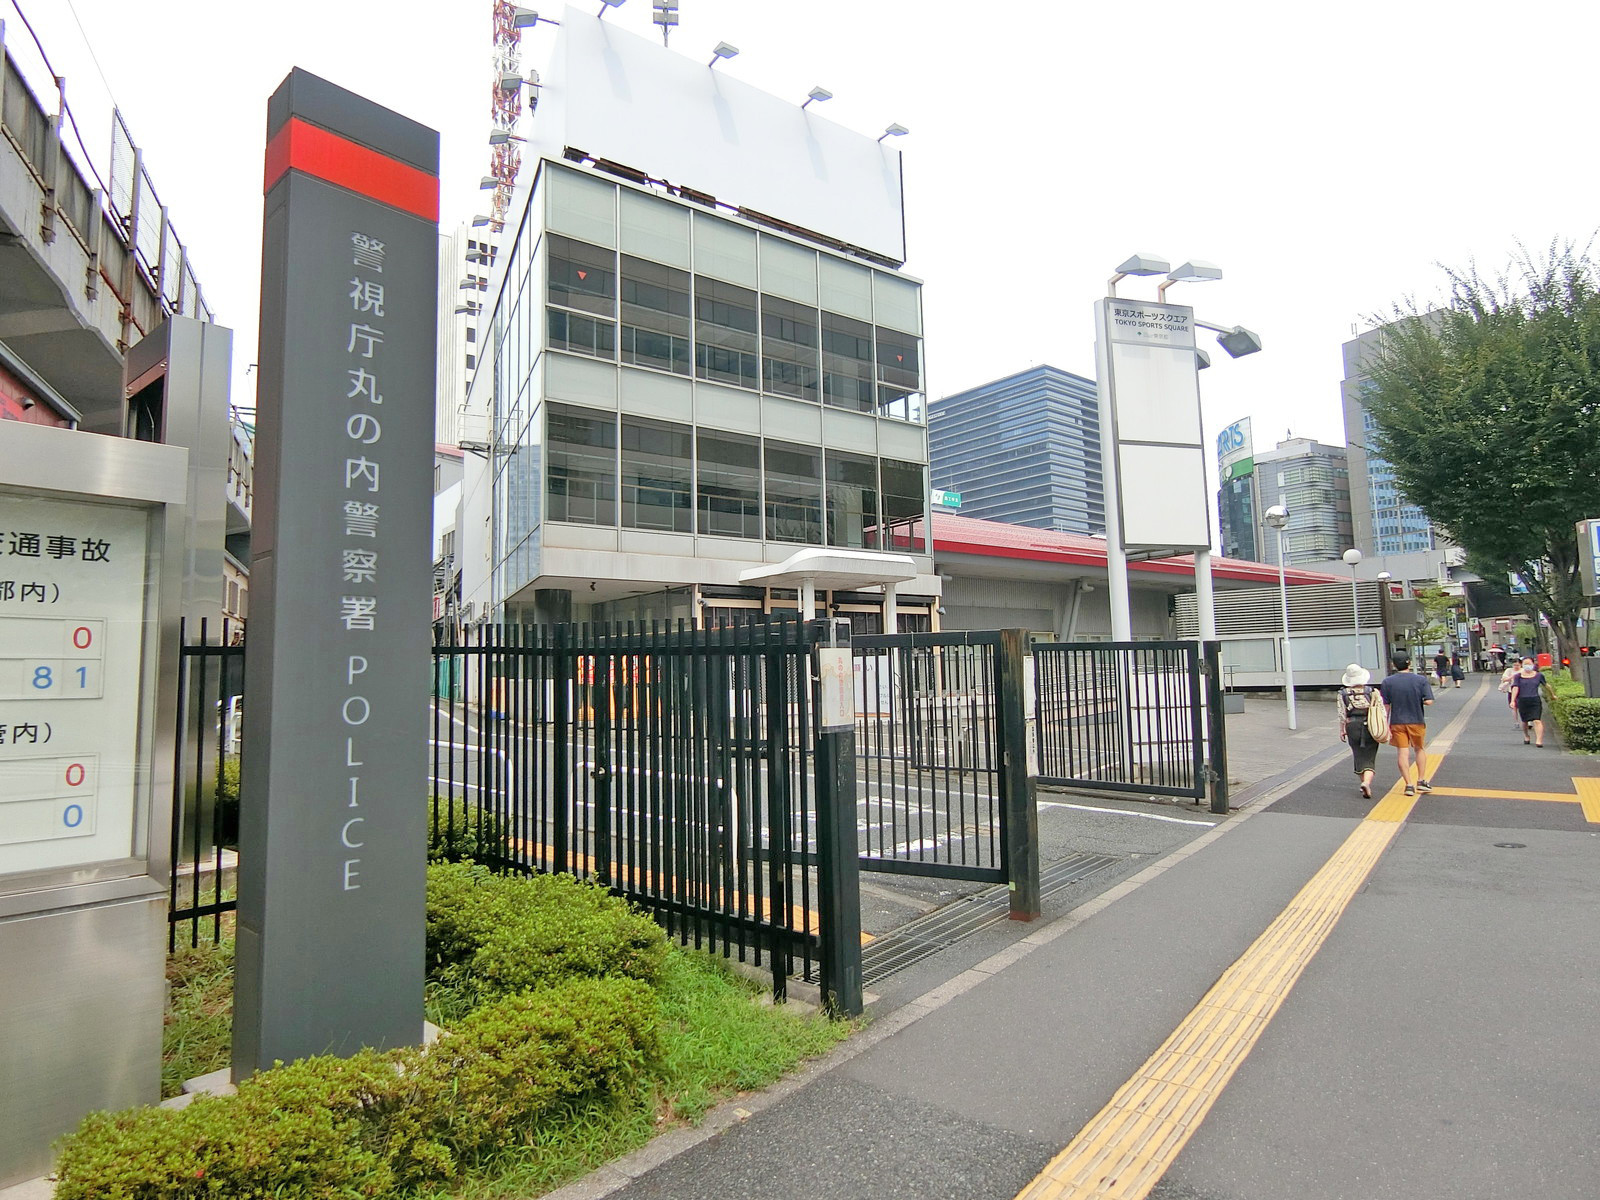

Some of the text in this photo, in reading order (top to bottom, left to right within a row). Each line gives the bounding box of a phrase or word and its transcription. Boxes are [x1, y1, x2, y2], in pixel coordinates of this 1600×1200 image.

[1114, 308, 1188, 323] 東京スポーツスクエア
[1114, 318, 1189, 333] TOKYO SPORTS SQUARE
[340, 231, 387, 632] 警視庁丸の内警察署
[0, 531, 111, 563] 通事故
[72, 626, 93, 650] 0
[1460, 638, 1468, 647] P
[0, 722, 52, 744] 内）
[65, 763, 86, 787] 0
[341, 656, 371, 891] POLICE
[63, 804, 84, 828] 0
